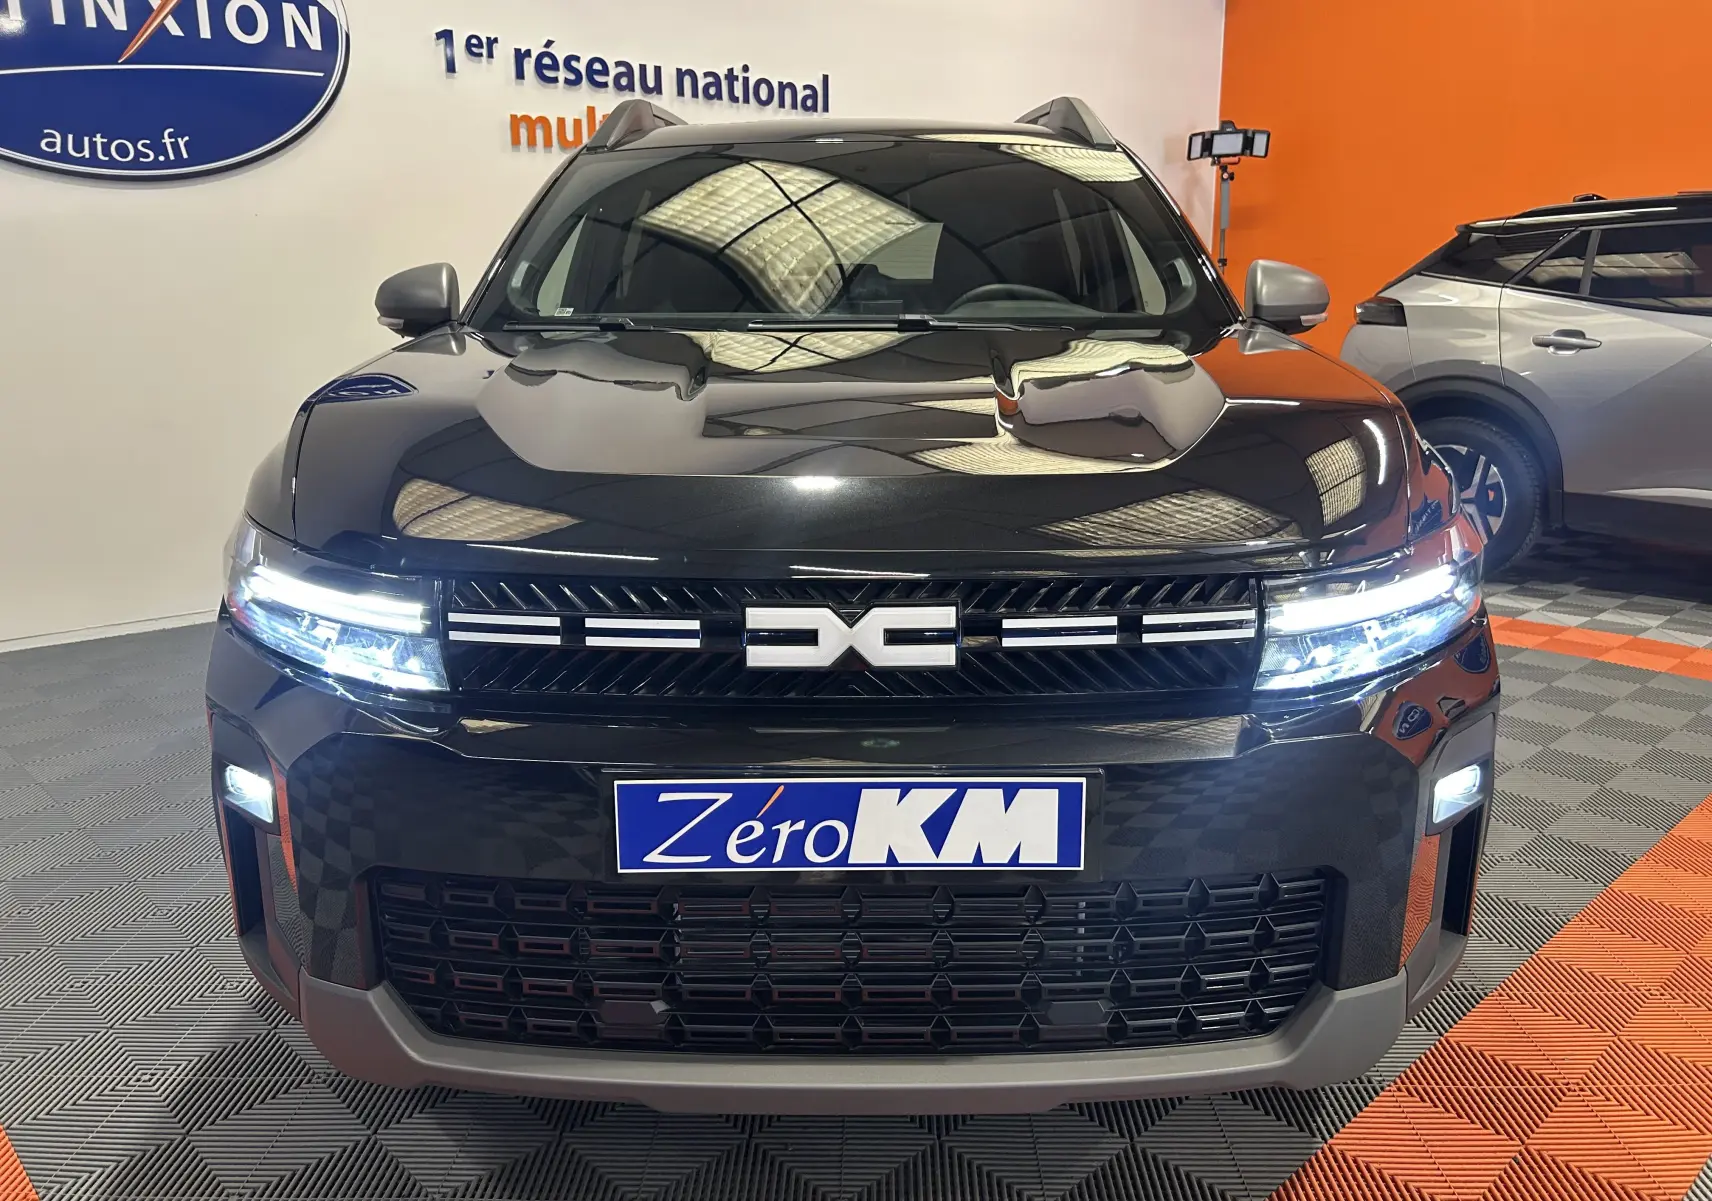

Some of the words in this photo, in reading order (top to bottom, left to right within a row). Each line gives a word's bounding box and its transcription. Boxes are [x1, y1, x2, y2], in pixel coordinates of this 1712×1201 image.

[514, 40, 663, 96] réseau
[676, 64, 830, 113] national
[40, 128, 190, 163] autos.fr
[510, 105, 611, 149] mul
